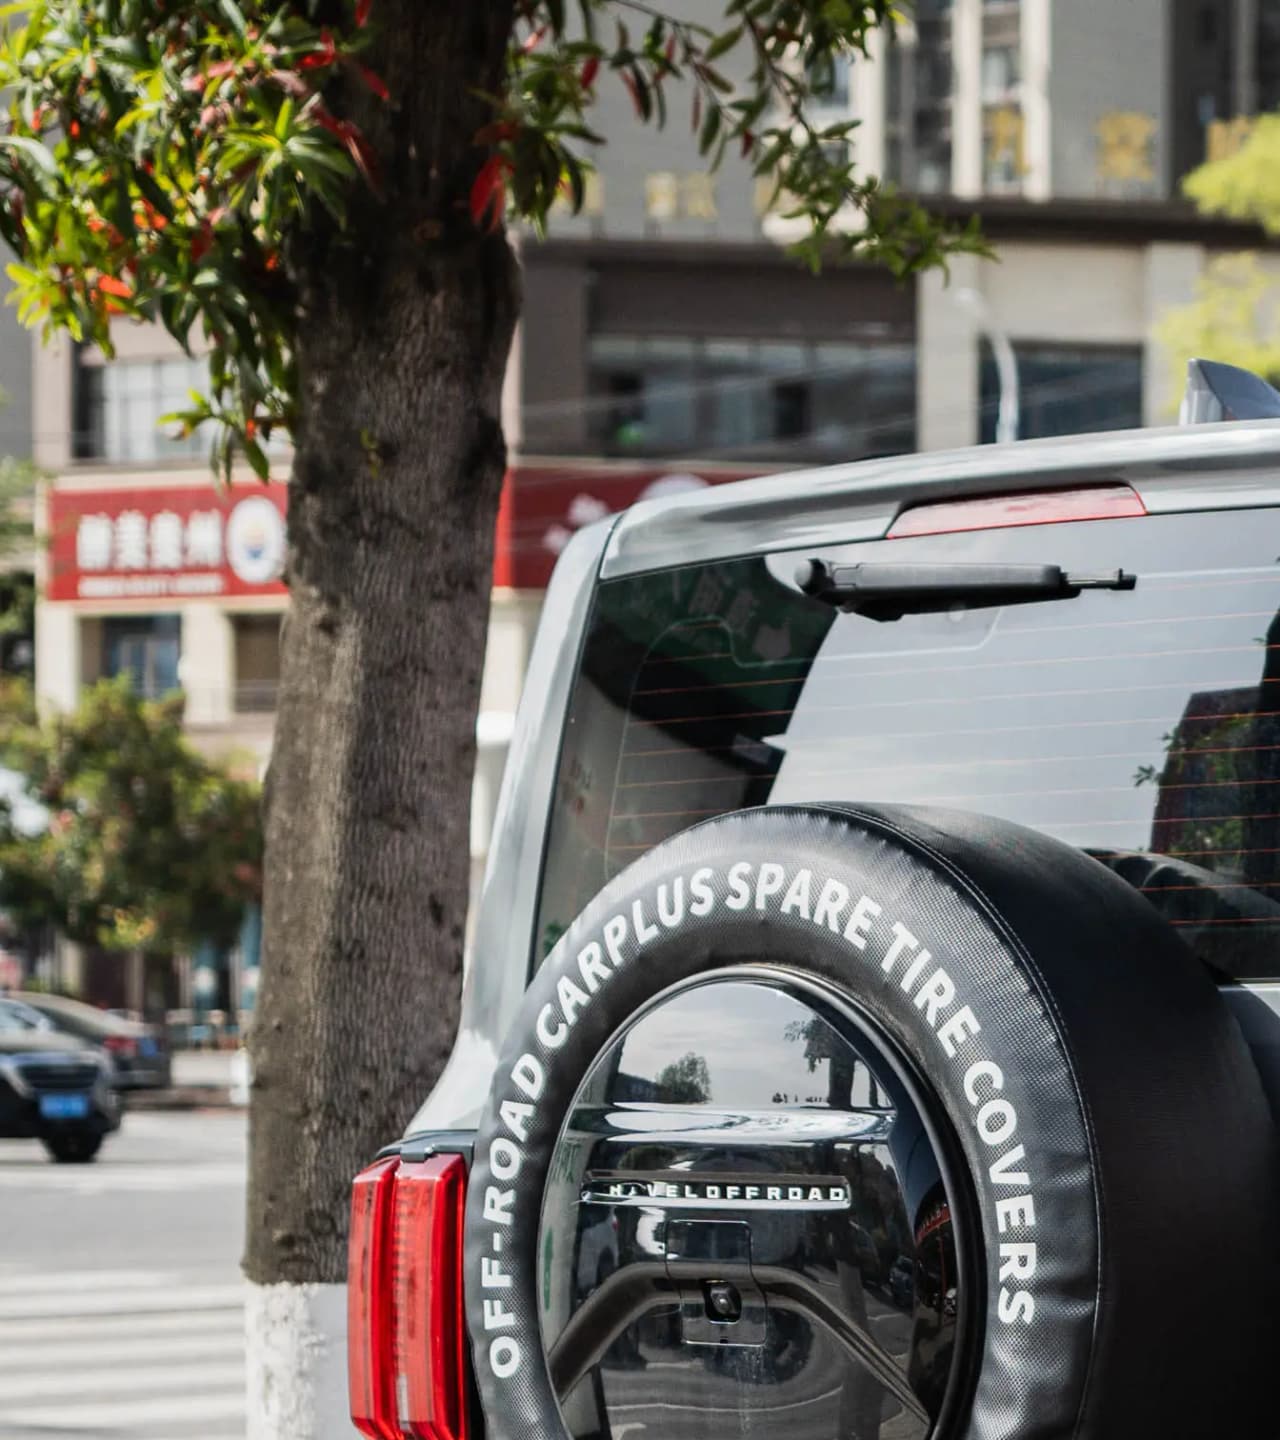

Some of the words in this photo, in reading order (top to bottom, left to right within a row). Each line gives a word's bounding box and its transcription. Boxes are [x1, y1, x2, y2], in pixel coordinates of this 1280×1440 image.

[482, 1053, 545, 1378] OFF-ROAD
[536, 866, 714, 1048] CARPLUS
[725, 861, 882, 950] SPARE
[880, 921, 981, 1058] TIRE
[963, 1060, 1036, 1326] COVERS
